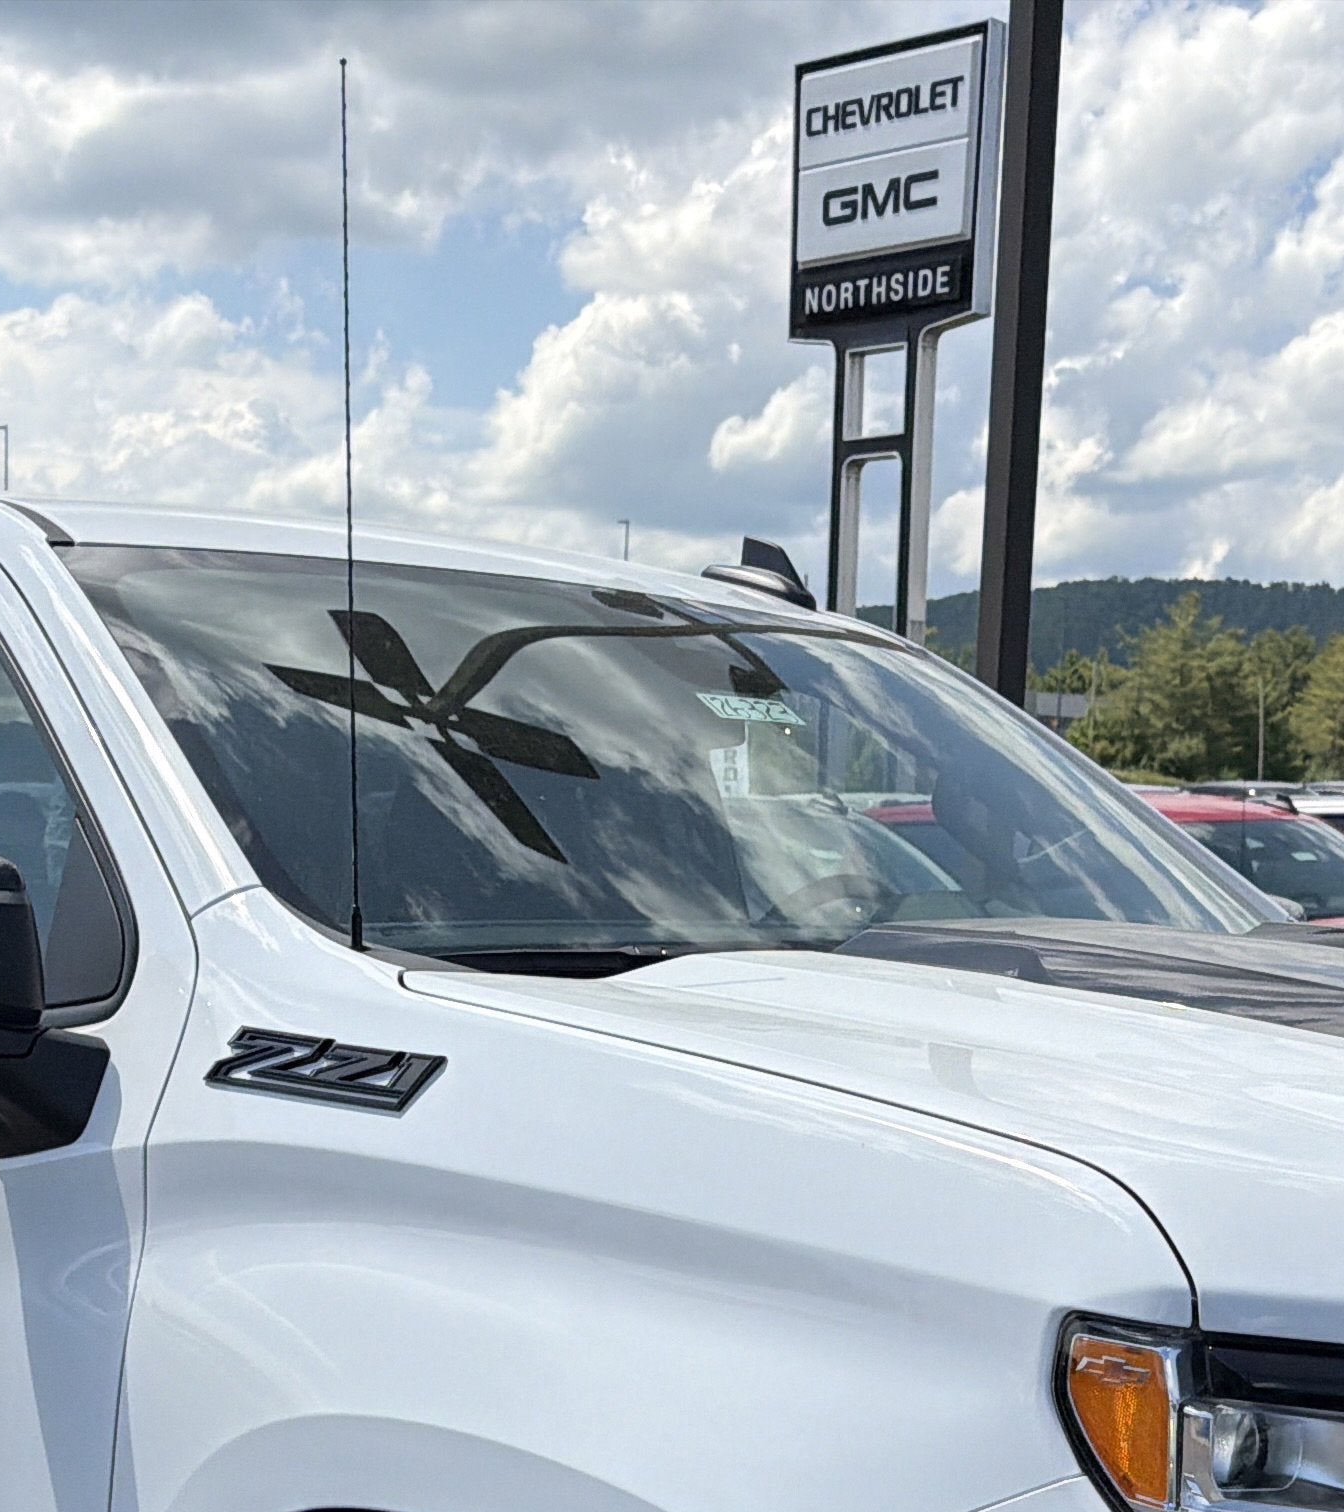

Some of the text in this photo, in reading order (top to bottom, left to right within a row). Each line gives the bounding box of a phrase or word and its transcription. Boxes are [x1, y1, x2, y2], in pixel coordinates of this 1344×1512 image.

[805, 75, 964, 138] CHEVROLET
[822, 169, 940, 227] GMC
[805, 265, 951, 315] NORTHSIDE
[203, 1025, 448, 1117] Z71
